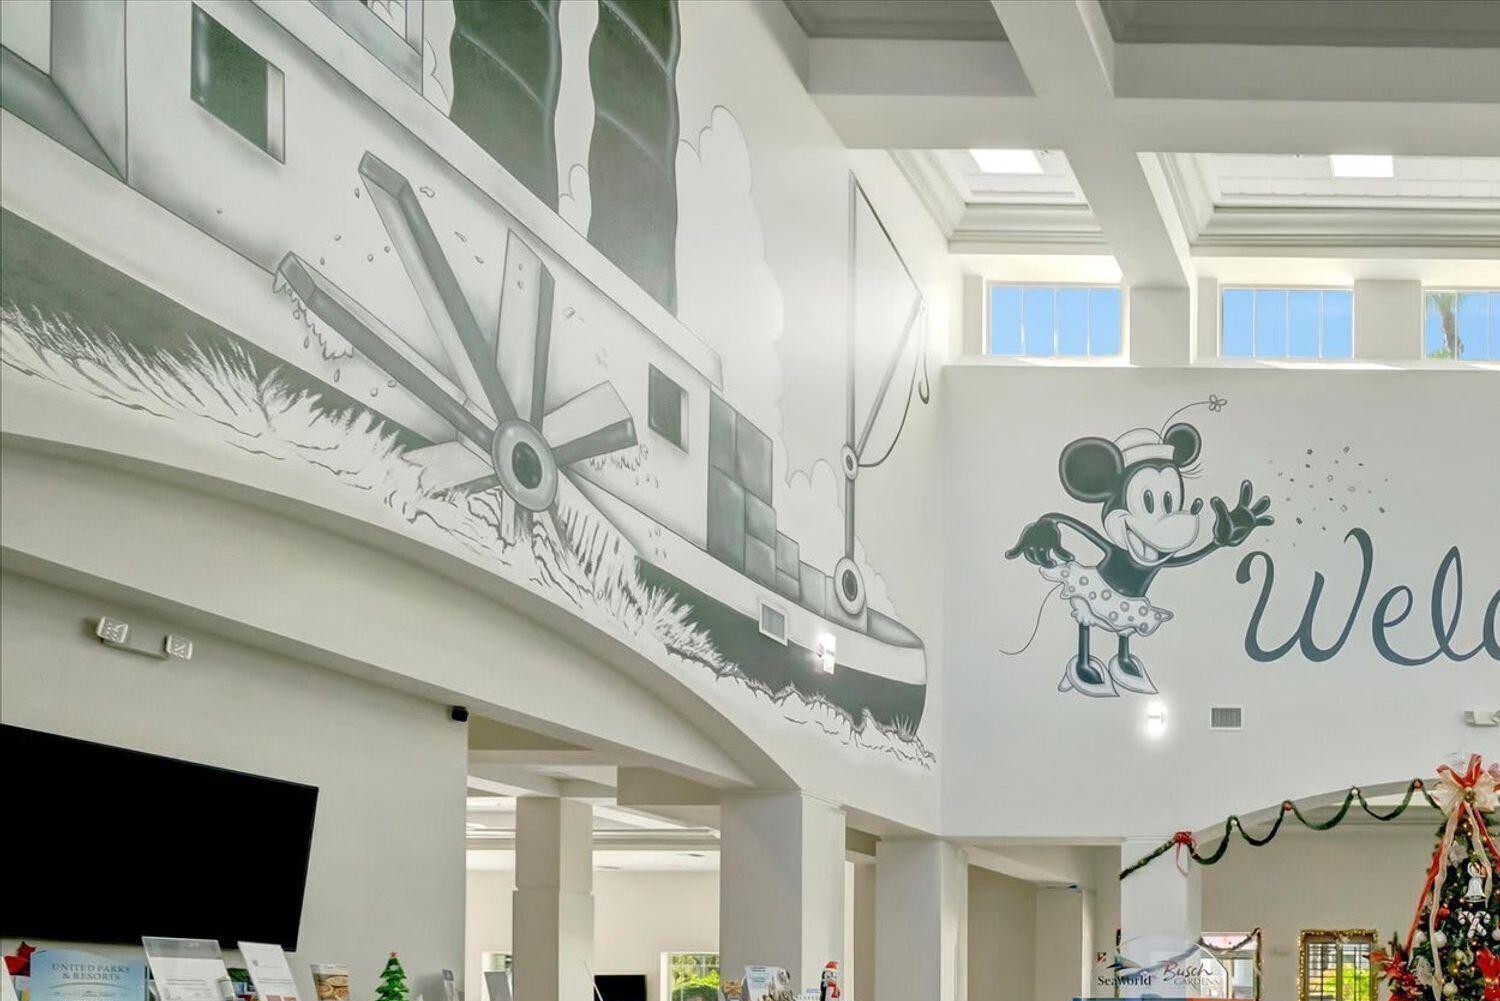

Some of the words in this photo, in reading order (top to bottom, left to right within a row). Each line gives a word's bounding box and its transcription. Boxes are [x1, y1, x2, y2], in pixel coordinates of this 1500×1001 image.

[52, 963, 96, 972] UNITED
[98, 964, 131, 973] PARKS
[73, 972, 121, 981] RESORTS
[1097, 975, 1152, 987] SeaWorld
[1158, 961, 1214, 982] Busch
